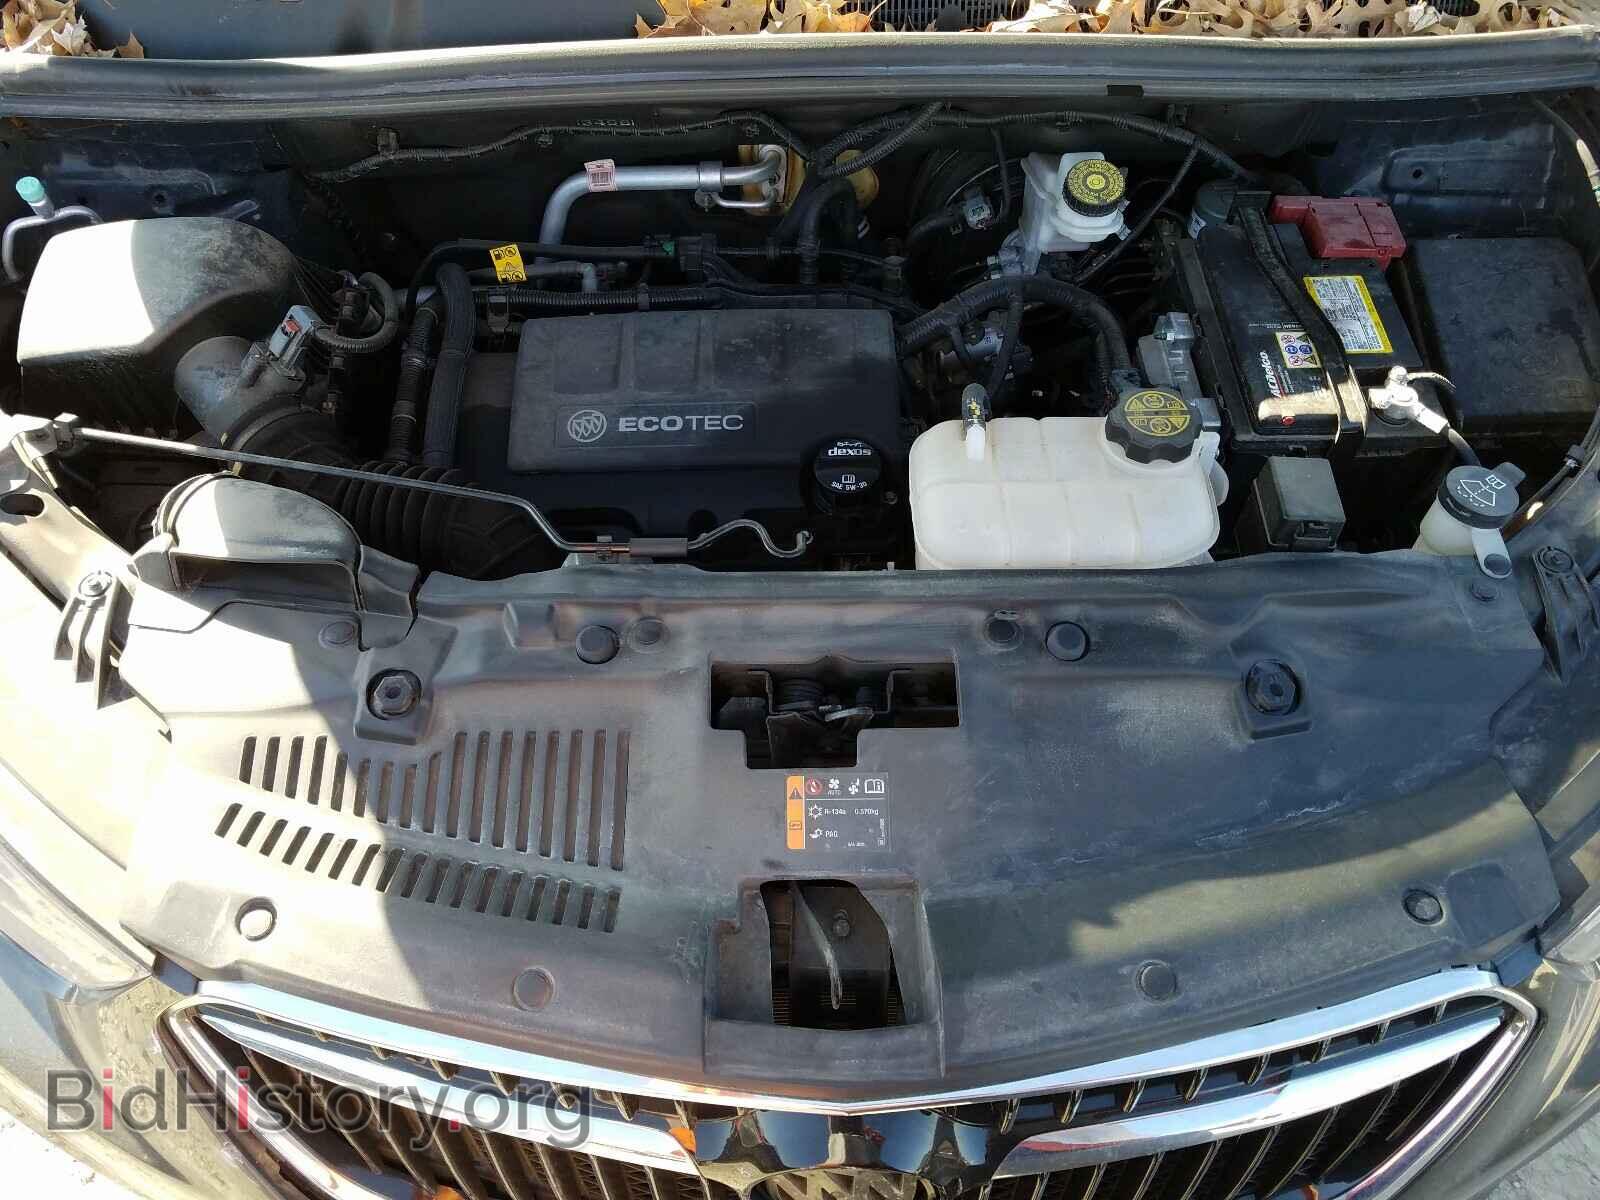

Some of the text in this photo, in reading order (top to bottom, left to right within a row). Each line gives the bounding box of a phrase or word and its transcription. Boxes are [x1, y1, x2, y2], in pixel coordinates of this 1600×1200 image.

[1260, 350, 1282, 398] ACDelco
[618, 414, 744, 432] ECOTEC
[828, 446, 872, 456] dexos
[831, 481, 868, 491] SAE 5W-30
[824, 808, 847, 816] R-134a
